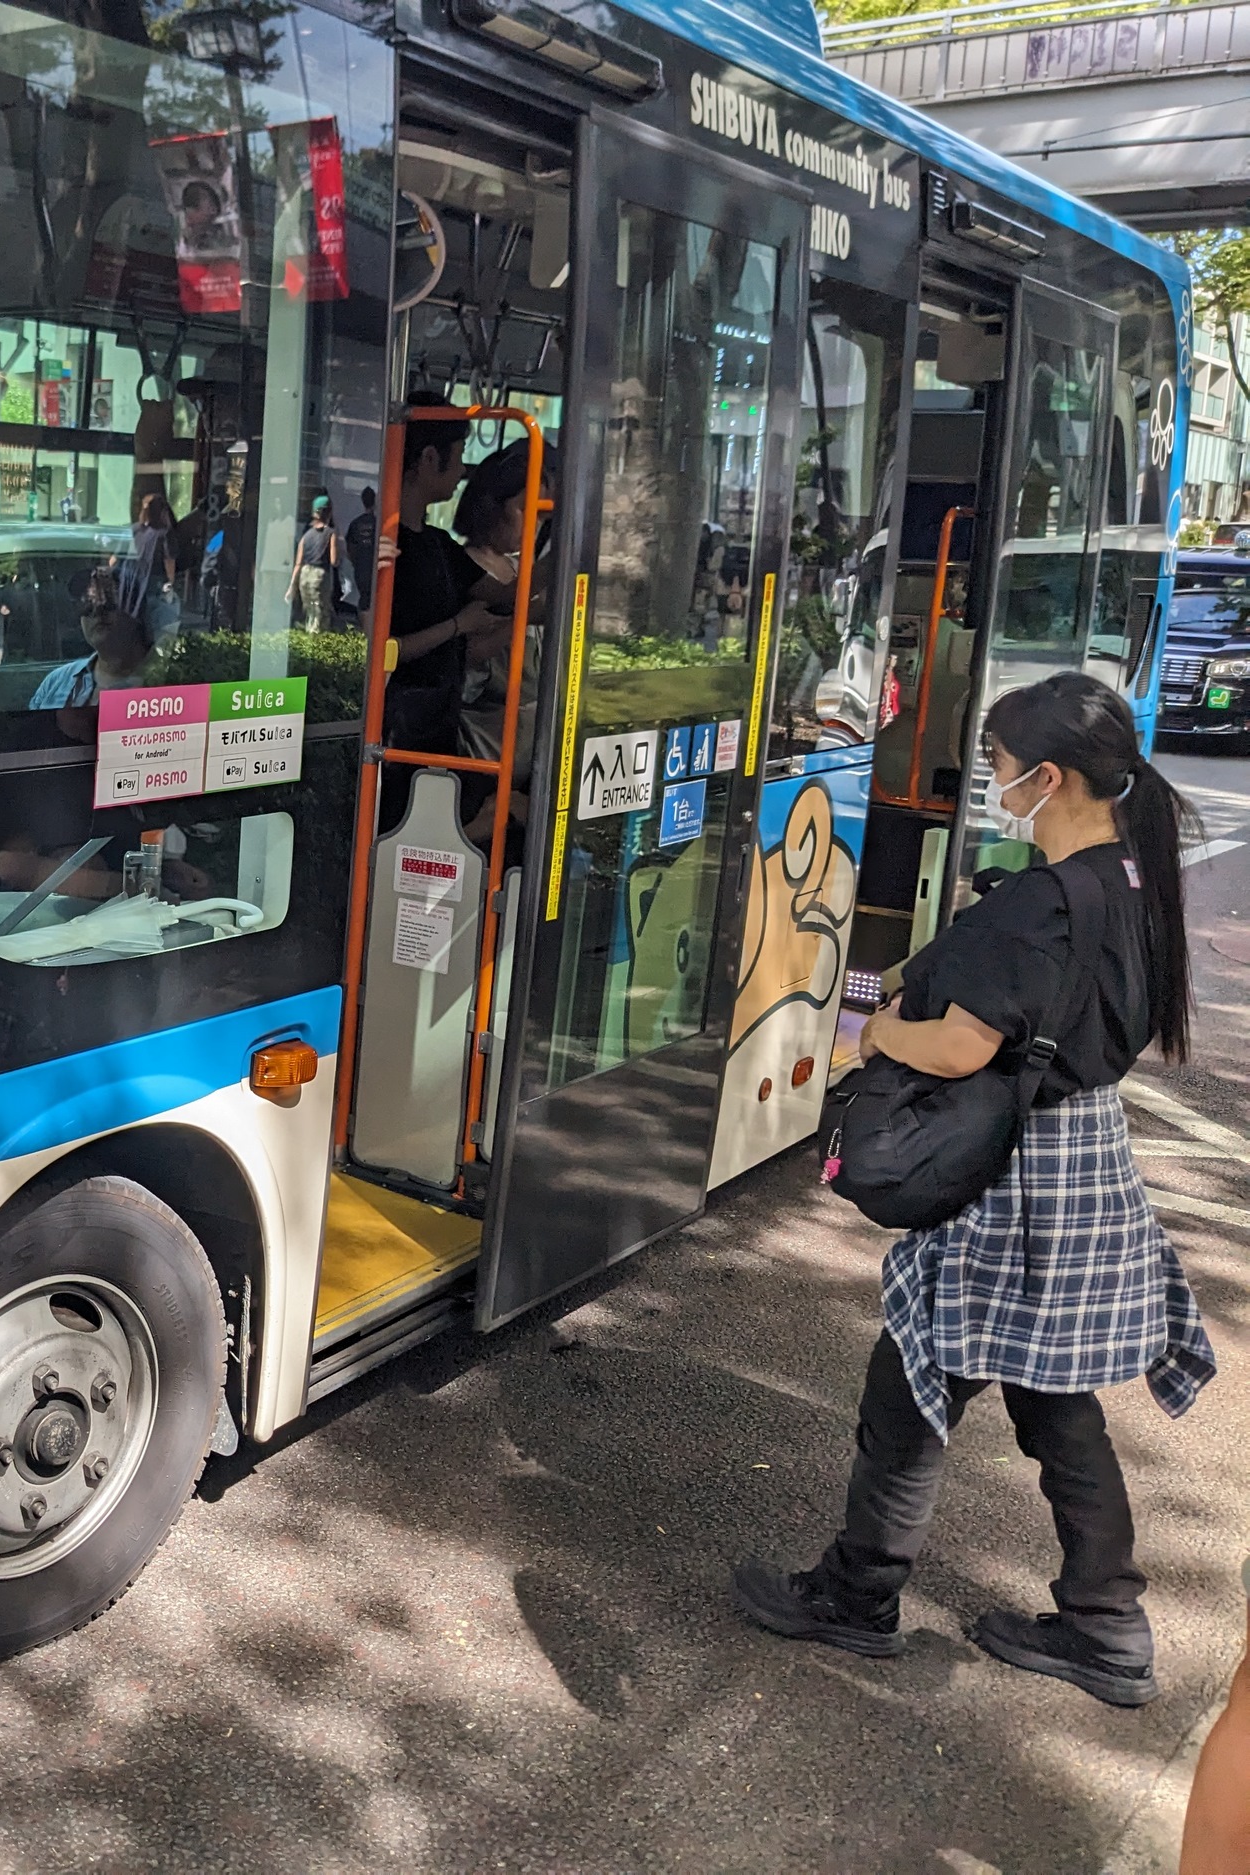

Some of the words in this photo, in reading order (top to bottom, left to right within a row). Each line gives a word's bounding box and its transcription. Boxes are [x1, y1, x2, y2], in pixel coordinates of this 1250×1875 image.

[690, 72, 780, 157] SHIBUYA
[784, 128, 879, 209] community
[883, 158, 911, 212] bus
[126, 696, 184, 719] PASMO
[231, 689, 285, 711] Suica
[134, 752, 144, 760] for
[610, 742, 649, 781] 入口
[122, 777, 136, 790] Pay
[145, 770, 188, 788] PASMO
[230, 765, 243, 778] Pay
[253, 760, 286, 774] Suica
[601, 783, 650, 808] ENTRANCE
[401, 847, 460, 865] 危険物持込禁止
